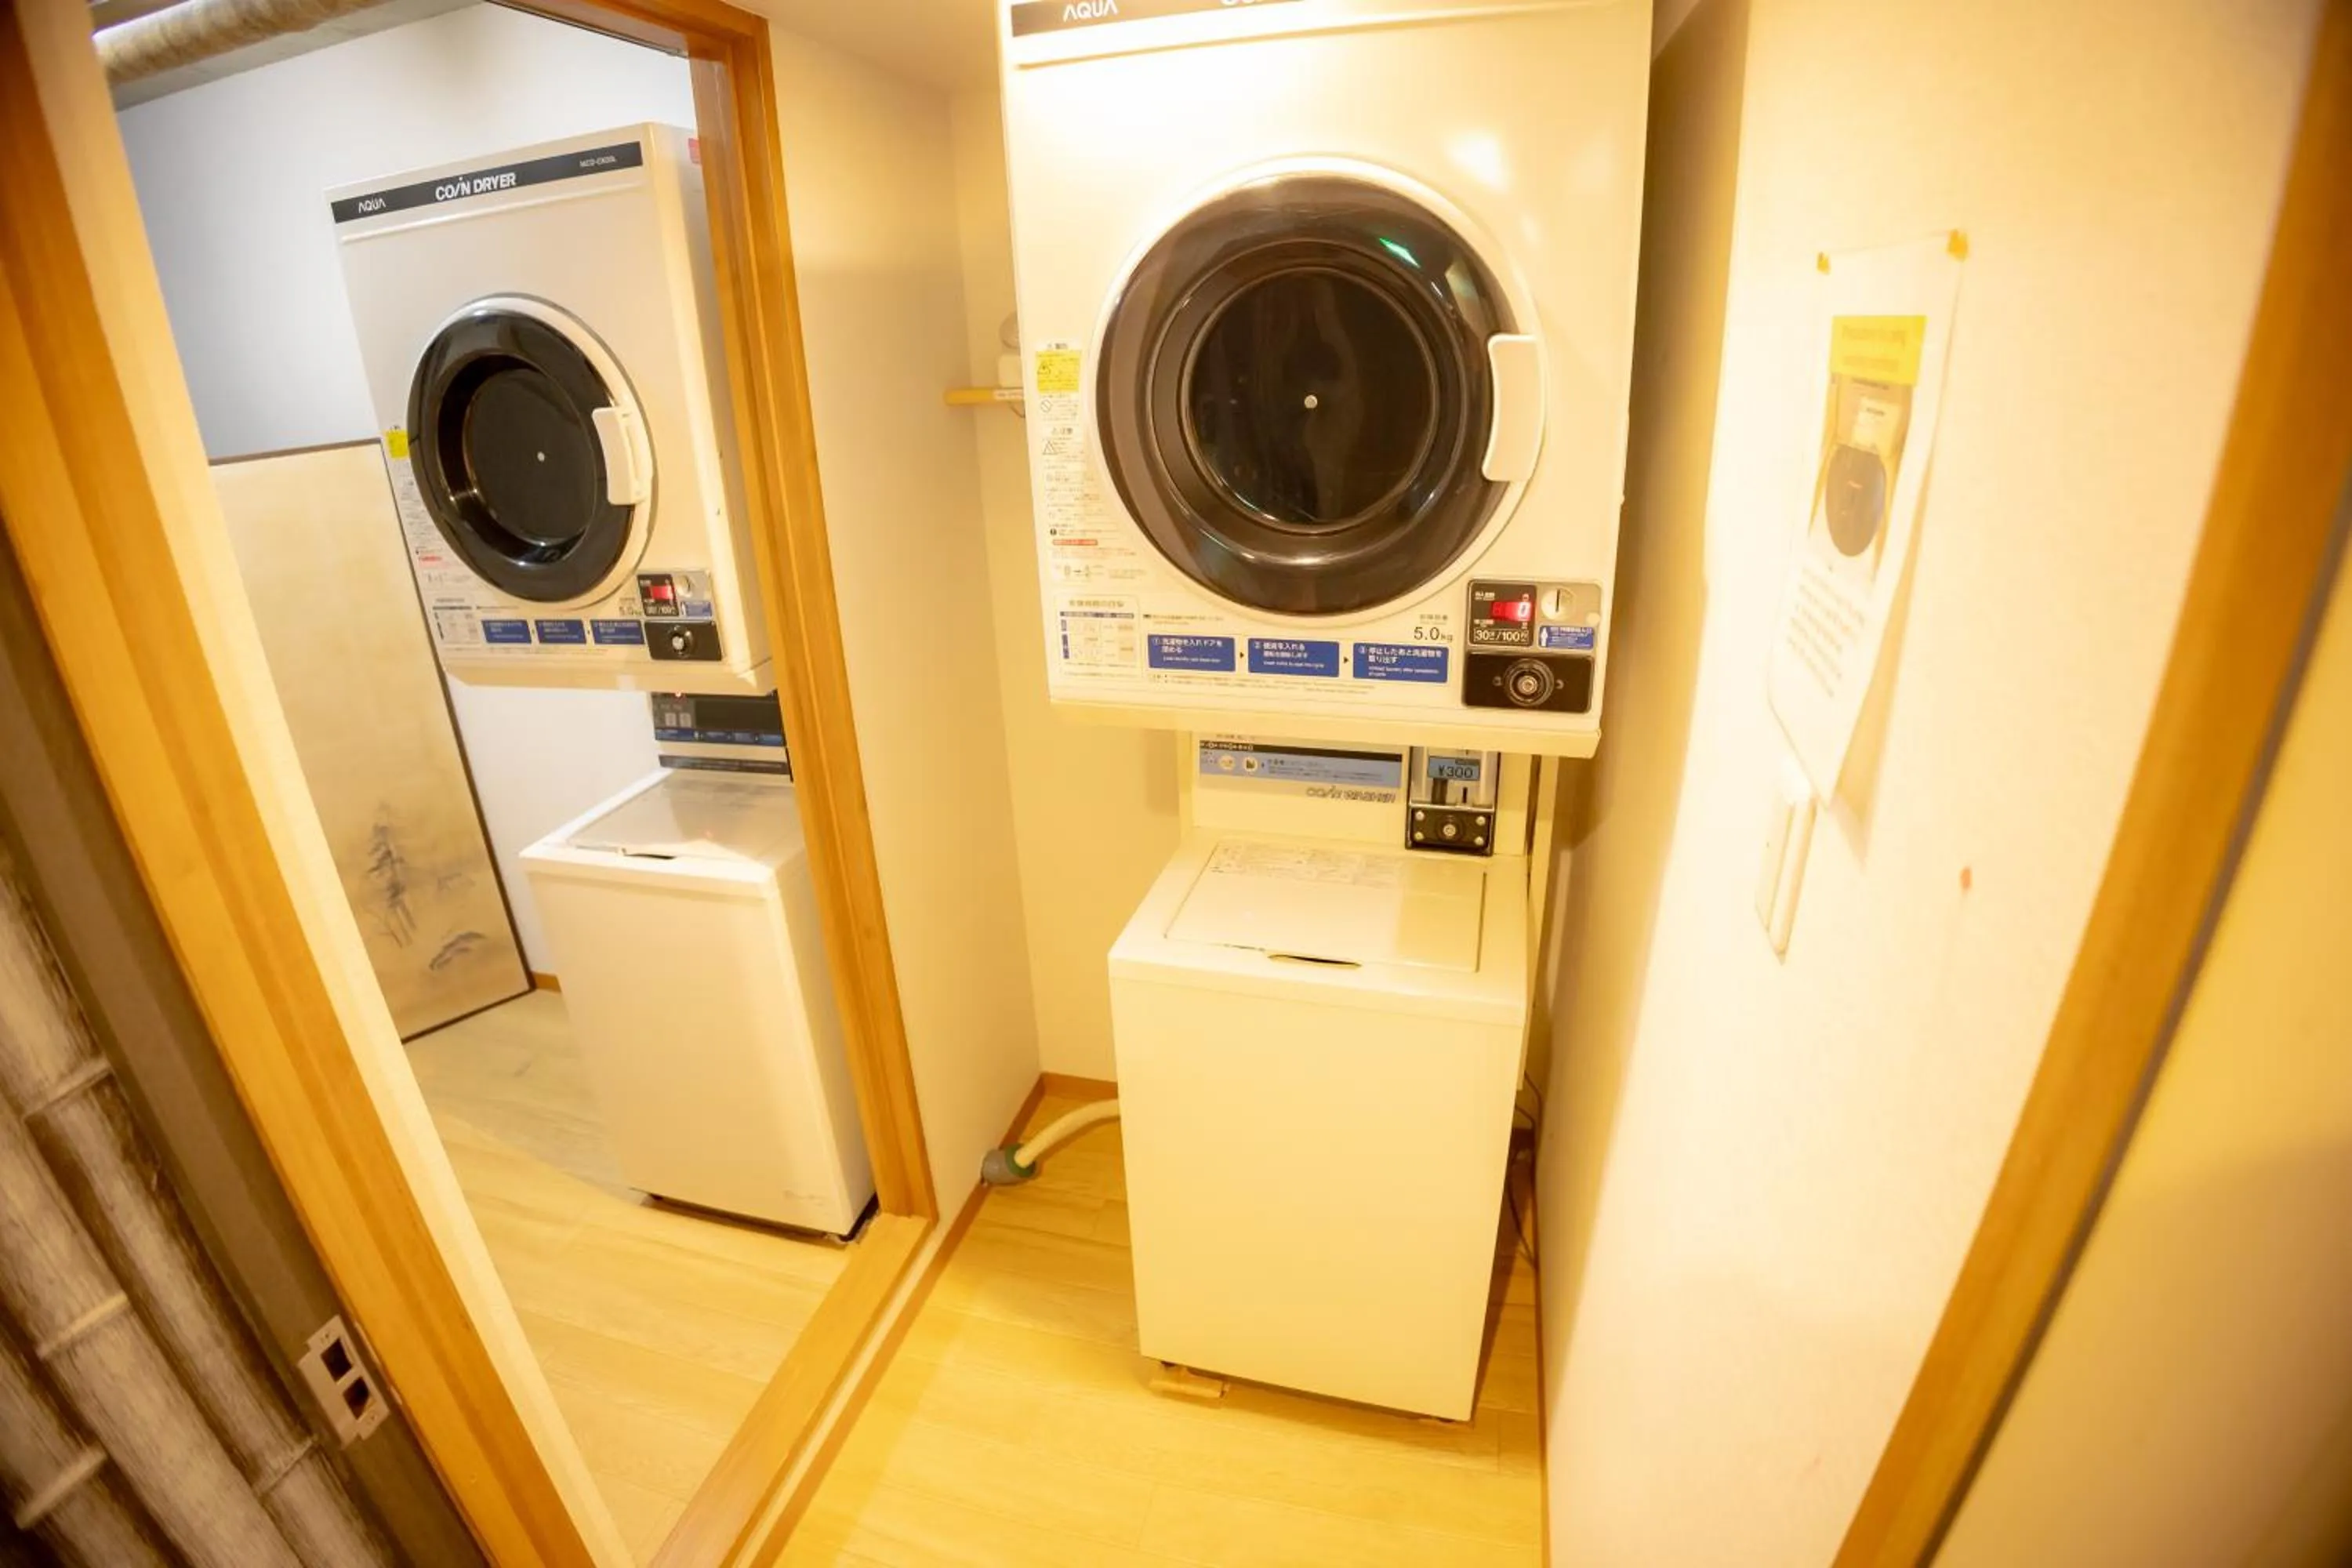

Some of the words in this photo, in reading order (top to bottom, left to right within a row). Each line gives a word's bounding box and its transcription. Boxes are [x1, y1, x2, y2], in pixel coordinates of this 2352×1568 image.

[1062, 0, 1119, 21] AQUA
[358, 198, 387, 213] AQUA
[474, 172, 517, 194] DRYER
